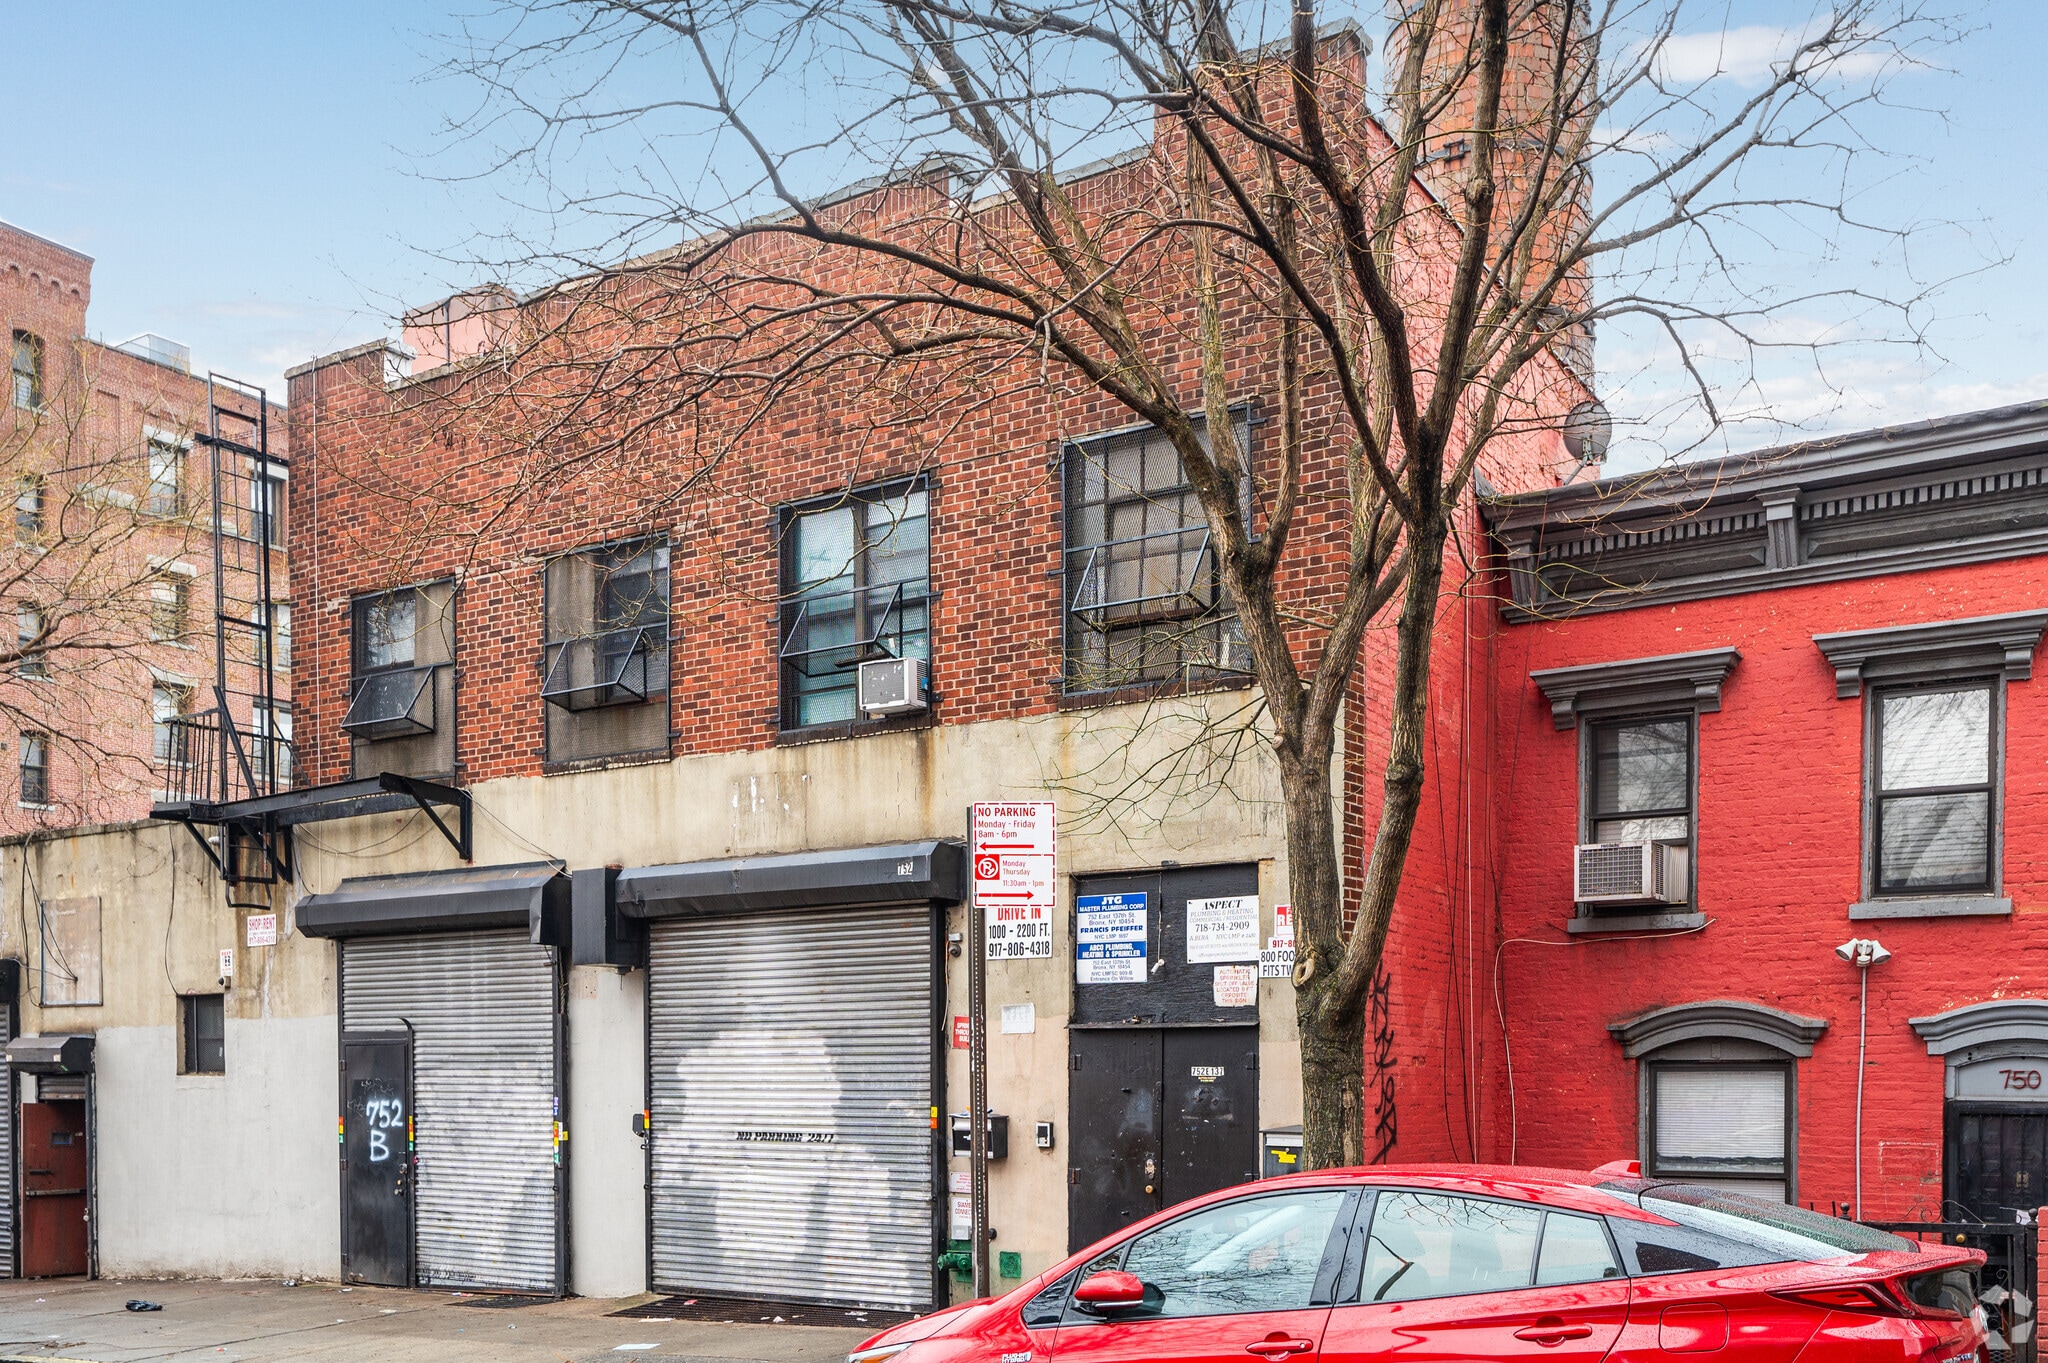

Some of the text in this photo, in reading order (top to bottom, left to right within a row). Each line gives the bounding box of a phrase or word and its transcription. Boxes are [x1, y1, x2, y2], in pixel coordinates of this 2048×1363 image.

[978, 807, 1036, 817] NO PARKING
[978, 820, 1006, 830] Monday
[1013, 820, 1036, 829] Friday
[1001, 830, 1017, 839] 6pm
[1102, 896, 1122, 905] JTG
[1202, 899, 1243, 910] ASPECT
[998, 908, 1041, 921] DRIVE IN
[1278, 914, 1293, 926] RE
[988, 924, 1006, 939] 1000
[1017, 923, 1036, 938] 2200
[1040, 923, 1050, 936] FT.
[1195, 921, 1250, 932] 718-734-2909
[988, 941, 1050, 957] 917-806-4318
[1261, 950, 1295, 962] 800 FOO
[1262, 964, 1292, 976] FITS TW
[1999, 1069, 2042, 1090] 750
[366, 1099, 404, 1128] 752
[736, 1132, 834, 1143] NO PARKING 24/7
[370, 1130, 390, 1162] B
